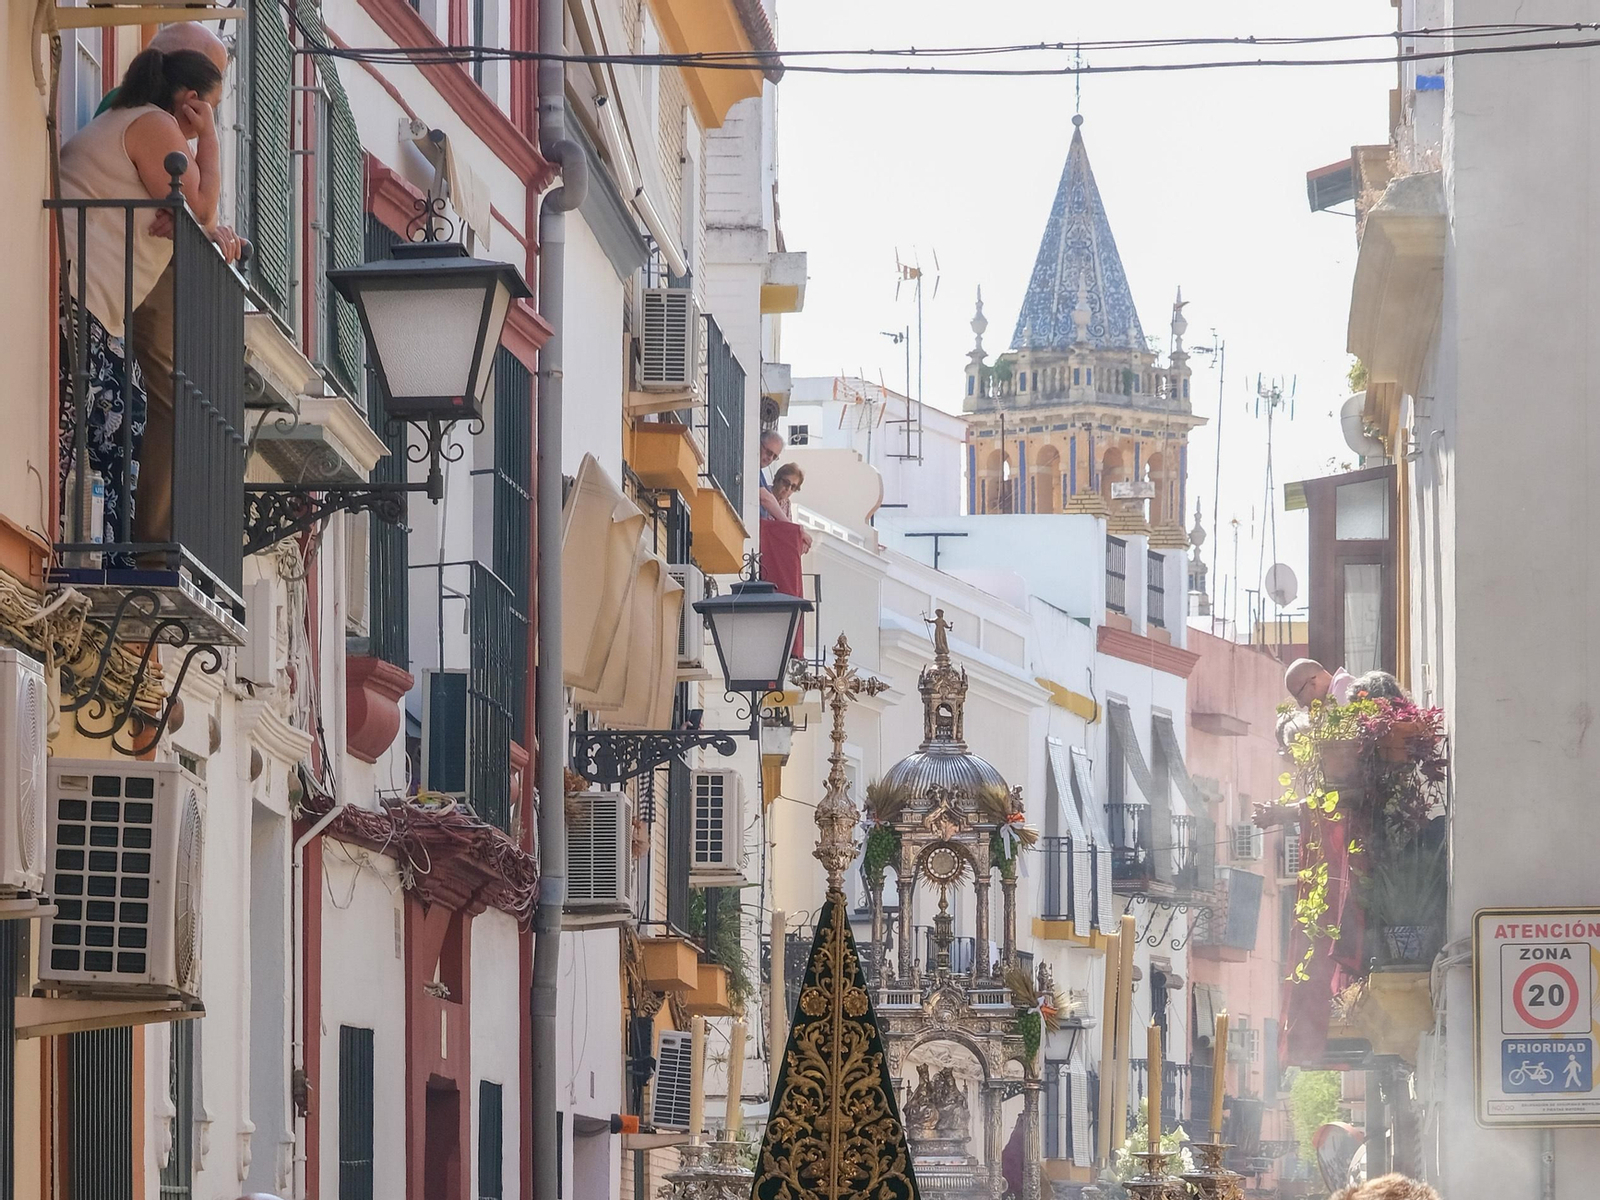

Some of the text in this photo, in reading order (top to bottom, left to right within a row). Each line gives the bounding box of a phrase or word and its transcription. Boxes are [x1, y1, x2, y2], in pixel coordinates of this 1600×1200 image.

[1494, 919, 1600, 939] ATENCIÓN
[1519, 947, 1572, 960] ZONA
[1528, 984, 1565, 1007] 20
[1507, 1043, 1586, 1053] PRIORIDAD
